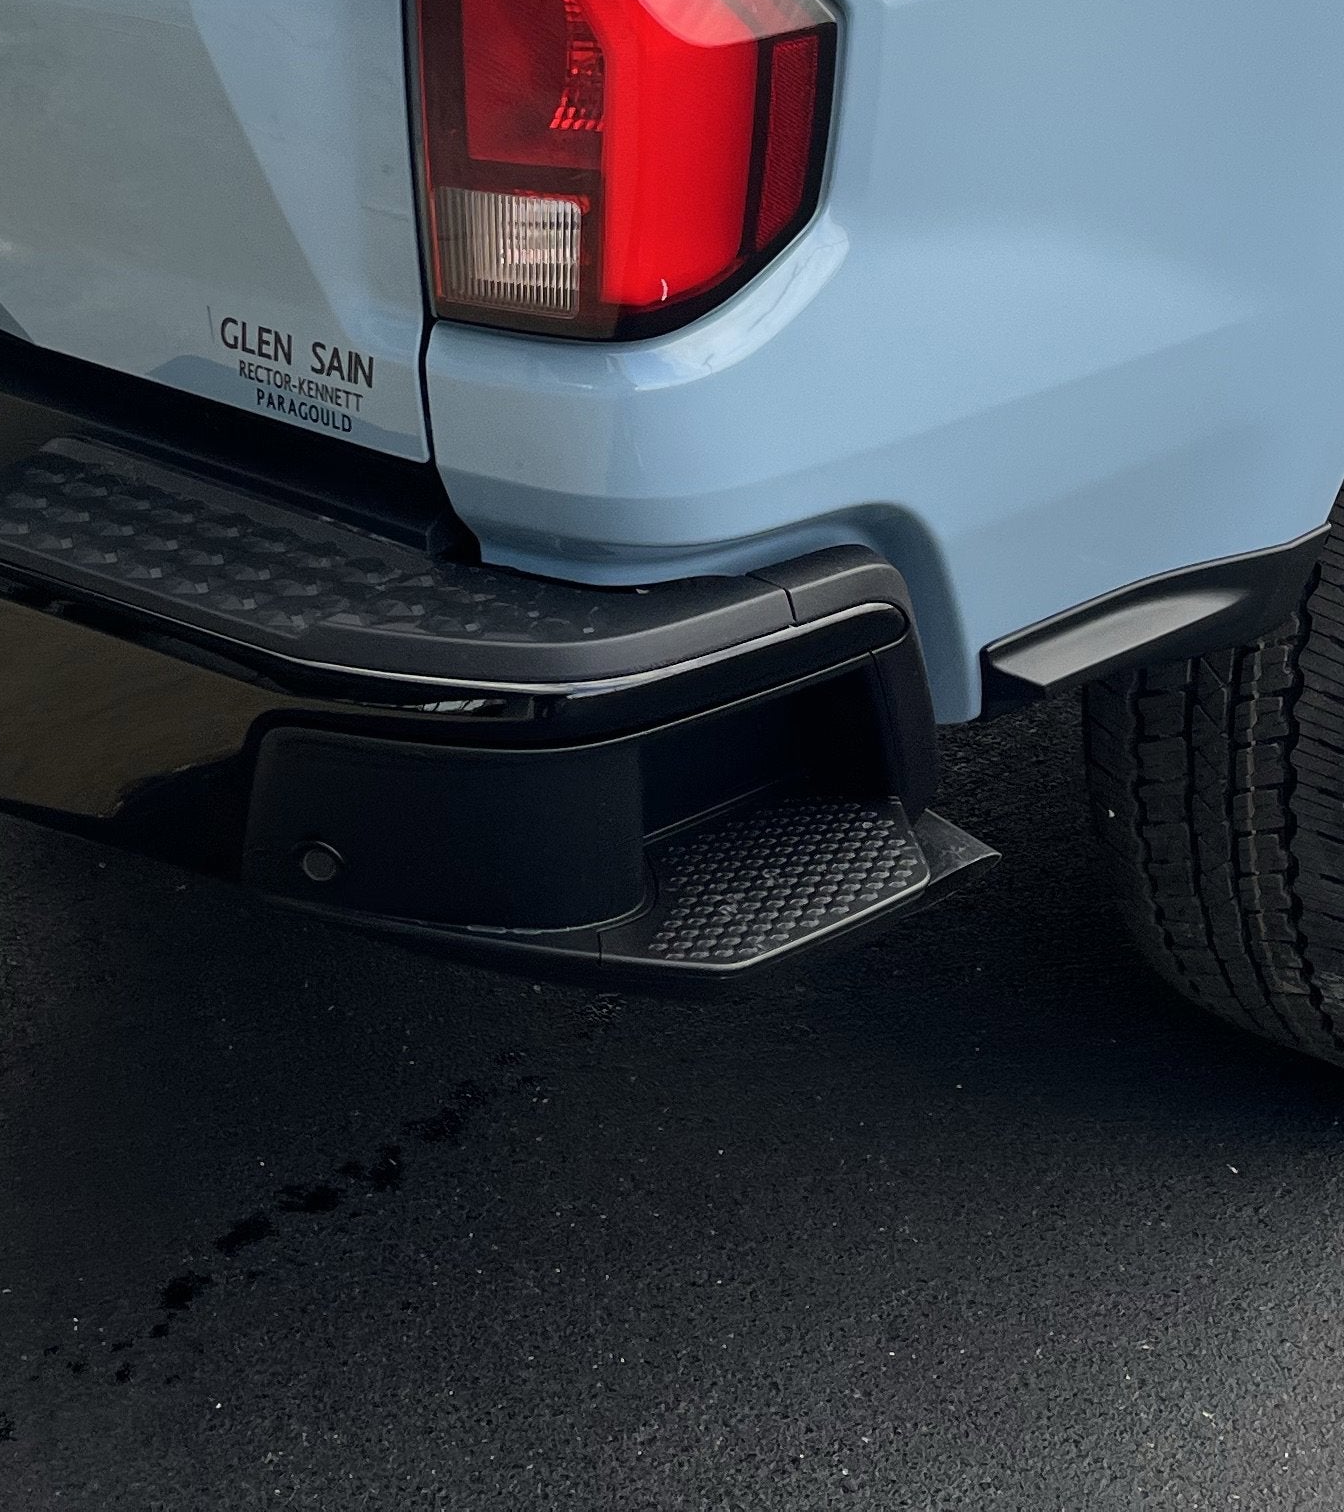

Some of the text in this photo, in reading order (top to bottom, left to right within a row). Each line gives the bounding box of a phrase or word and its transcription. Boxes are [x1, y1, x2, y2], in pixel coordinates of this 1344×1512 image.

[220, 317, 374, 388] GLEN SAIN
[239, 359, 364, 412] RECTOR-KENNETT
[256, 388, 352, 433] PARAGOULD
